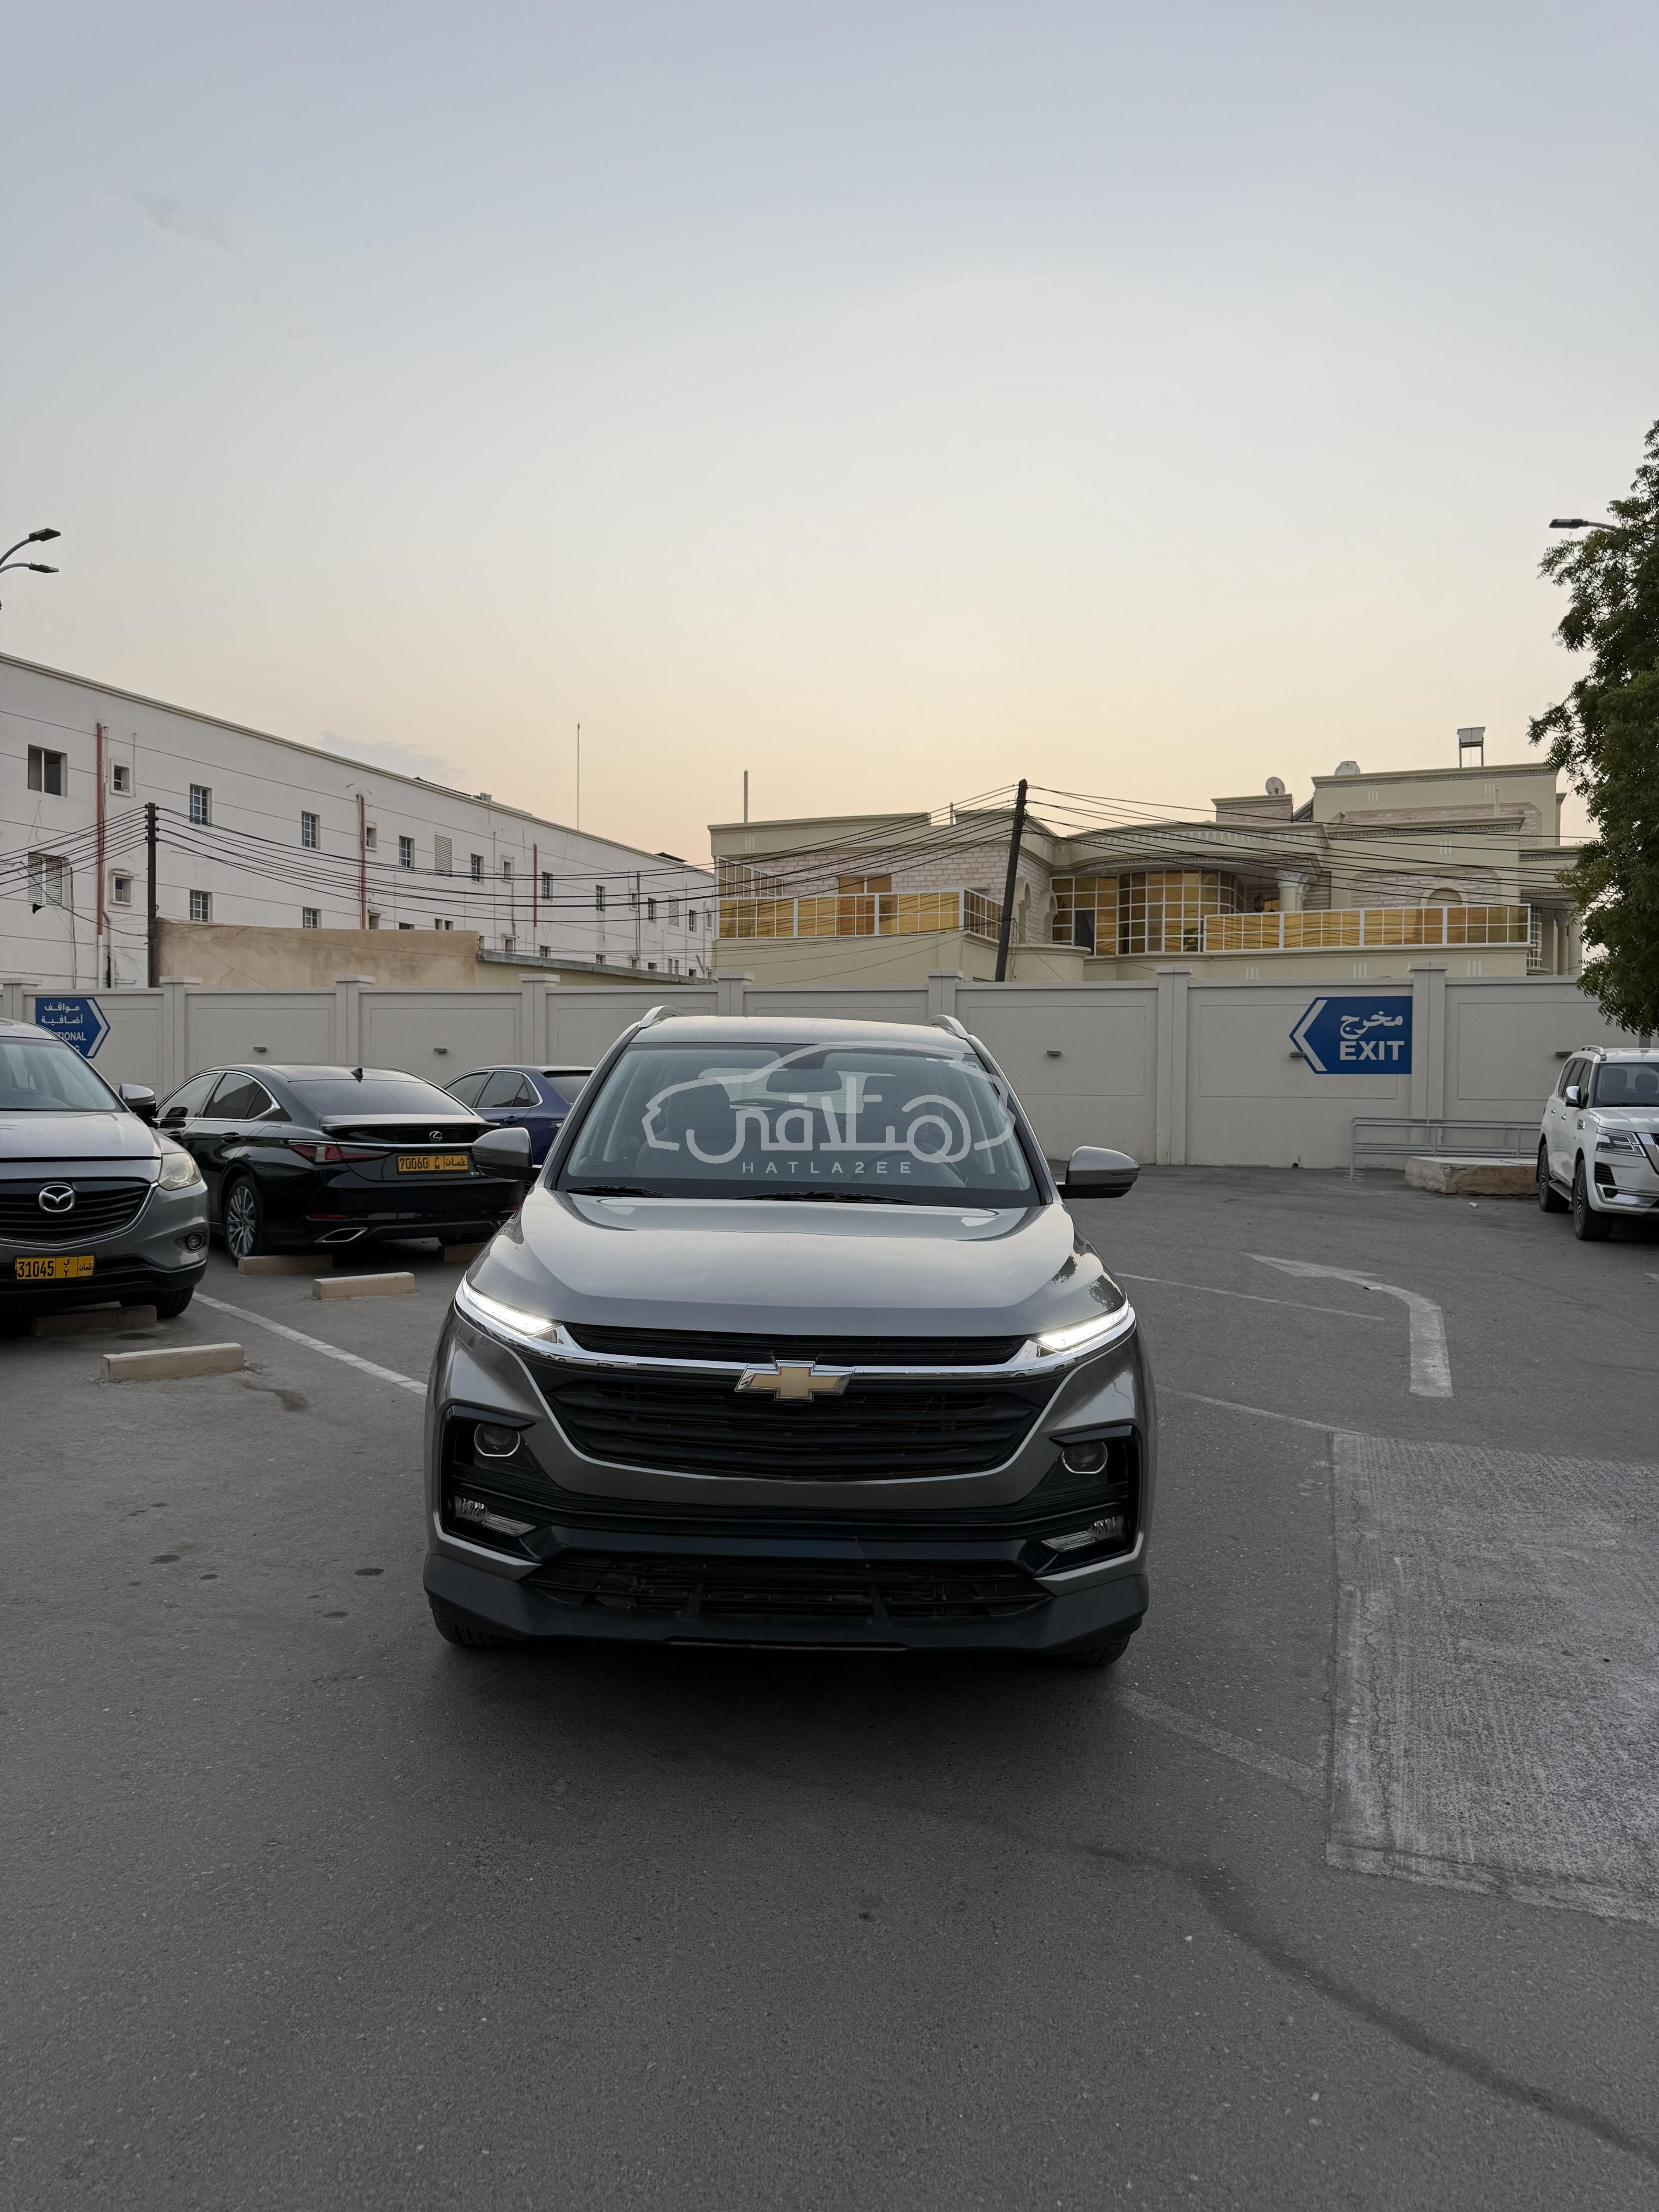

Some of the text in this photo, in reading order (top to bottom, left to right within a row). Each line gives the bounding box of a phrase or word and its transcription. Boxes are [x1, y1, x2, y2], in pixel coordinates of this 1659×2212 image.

[44, 1002, 80, 1013] مواقف
[1340, 1011, 1403, 1039] مخرج
[56, 1032, 86, 1041] TIONAL
[1340, 1041, 1405, 1060] EXIT
[400, 1157, 428, 1169] 70060
[18, 1261, 54, 1277] 31045
